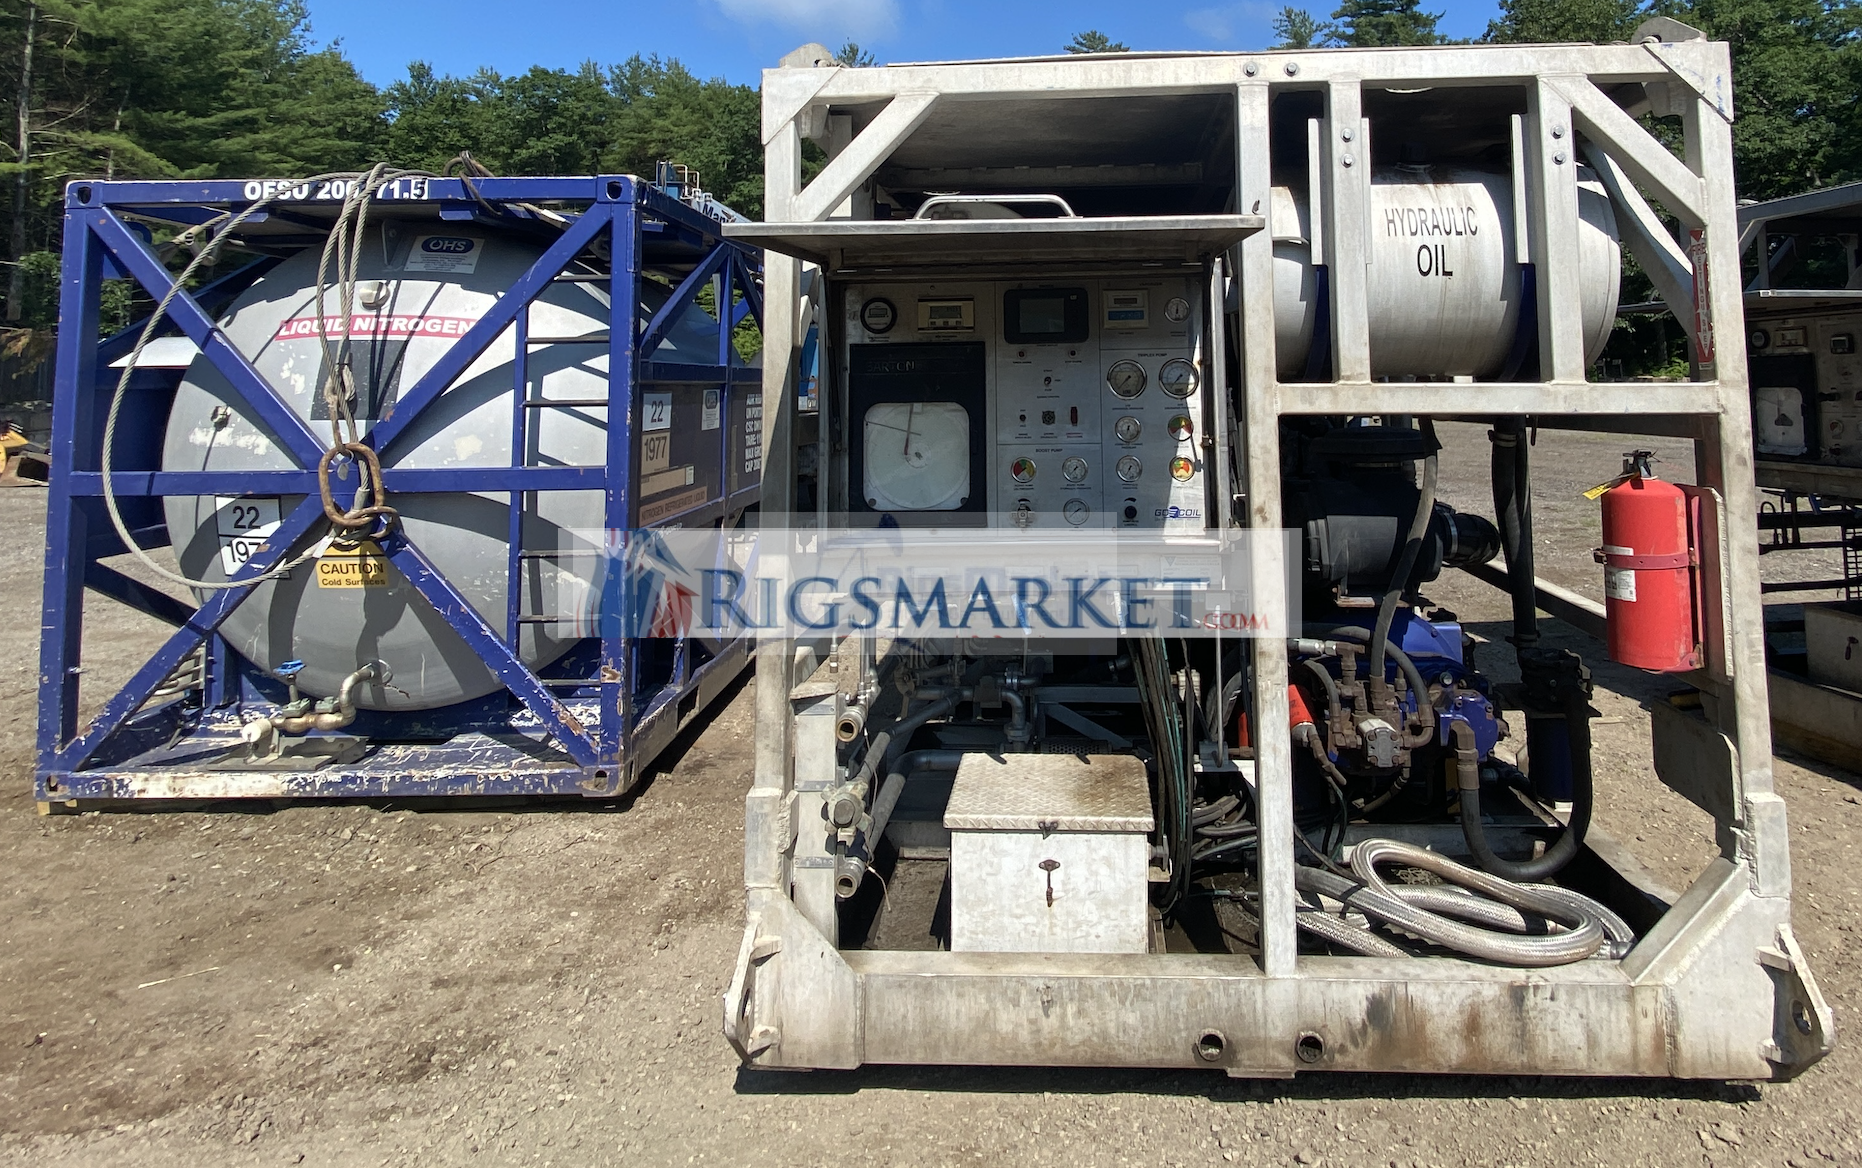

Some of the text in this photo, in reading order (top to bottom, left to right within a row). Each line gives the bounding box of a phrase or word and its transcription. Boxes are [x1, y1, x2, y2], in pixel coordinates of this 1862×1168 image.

[1384, 206, 1478, 237] HYDRAULIC
[429, 239, 467, 251] OHS
[1417, 244, 1453, 277] OIL
[278, 316, 476, 336] LIQUID NITROGEN
[650, 400, 664, 423] 22
[644, 436, 667, 462] 1977
[232, 505, 261, 530] 22
[226, 540, 261, 564] 197
[320, 563, 384, 575] CAUTION
[321, 578, 386, 586] Cold Surfaces
